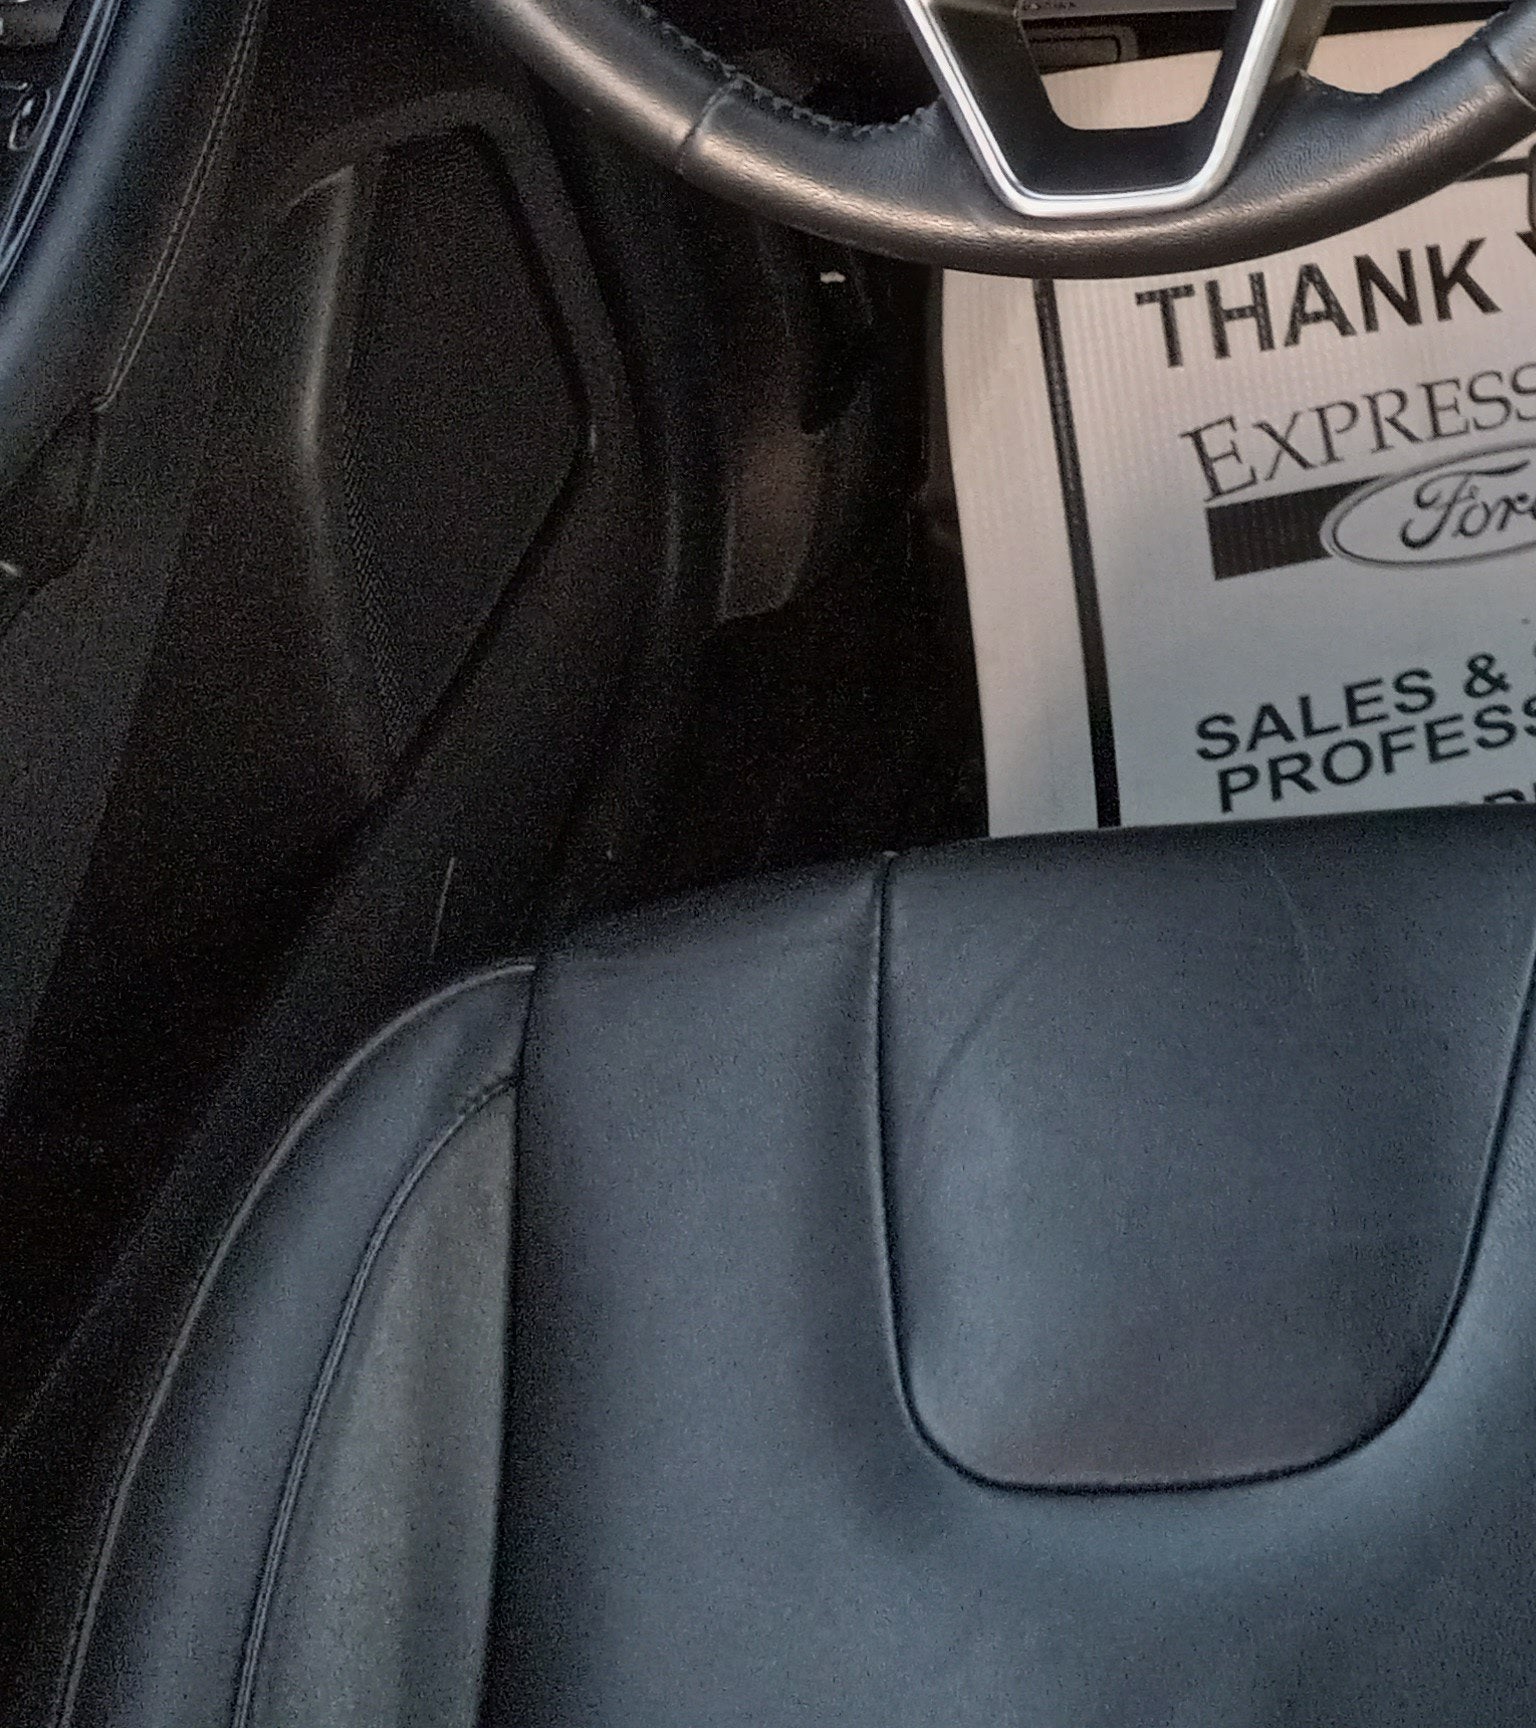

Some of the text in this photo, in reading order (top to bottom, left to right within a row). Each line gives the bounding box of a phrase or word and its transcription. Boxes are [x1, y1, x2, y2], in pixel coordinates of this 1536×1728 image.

[1135, 237, 1502, 369] THANK
[1195, 667, 1437, 762] SALES
[1463, 652, 1512, 701] &
